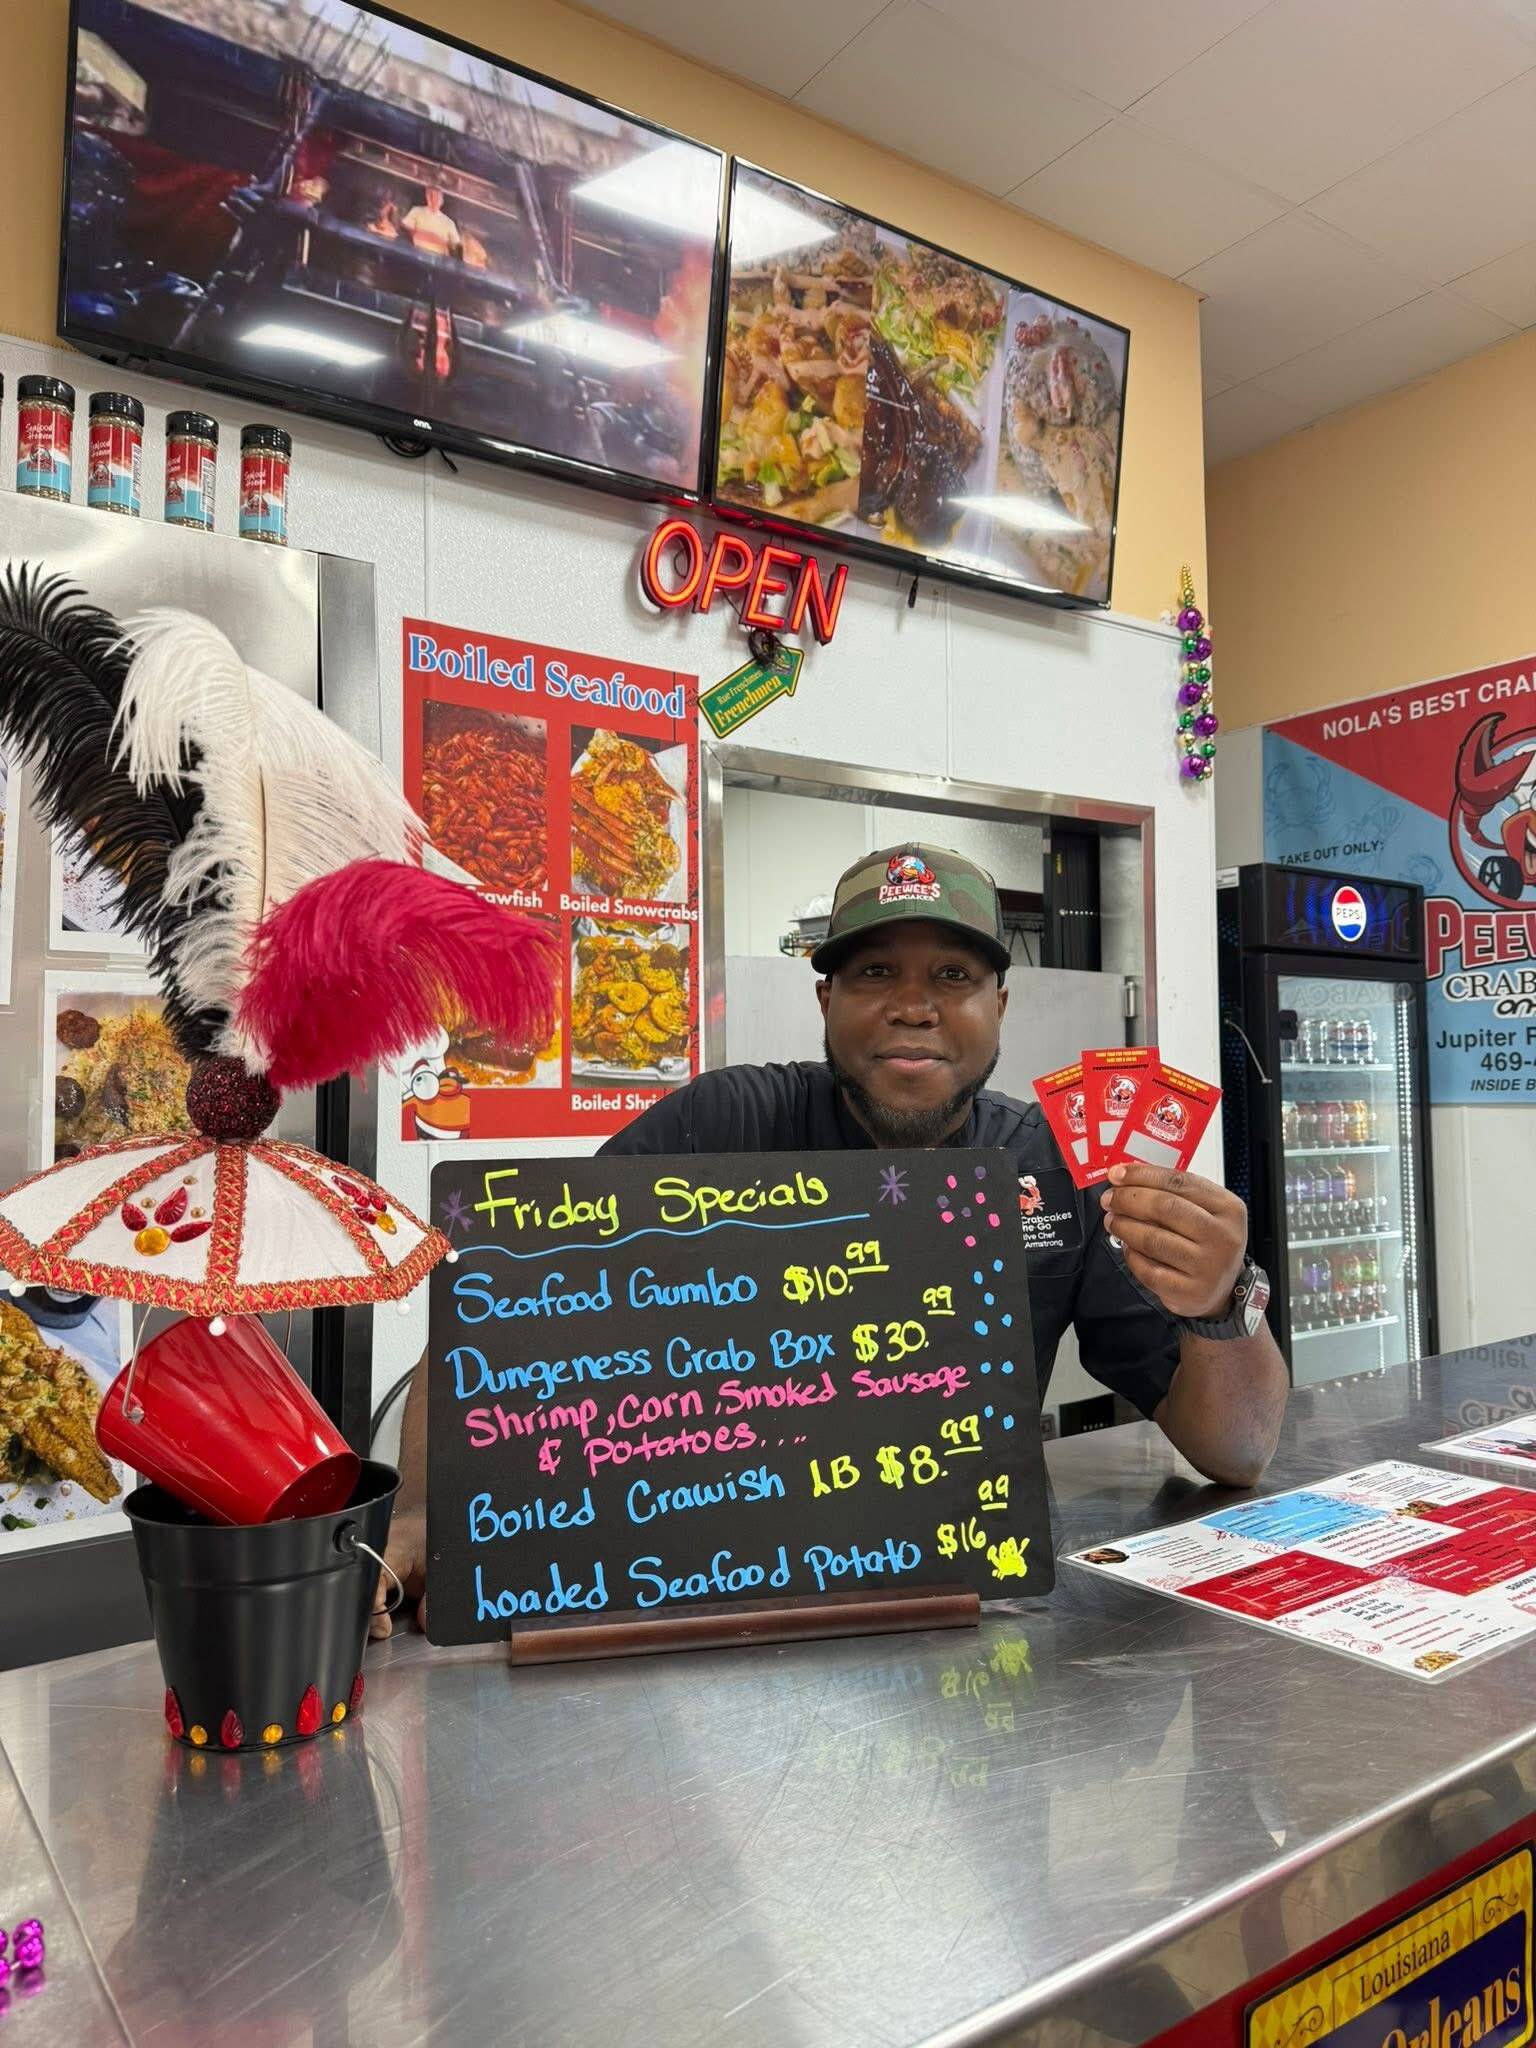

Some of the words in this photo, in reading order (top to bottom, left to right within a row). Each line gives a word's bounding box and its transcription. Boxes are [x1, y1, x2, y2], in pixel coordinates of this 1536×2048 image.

[642, 519, 848, 643] OPEN
[409, 633, 535, 692] Boiled
[545, 661, 686, 718] Seafood
[714, 675, 783, 727] Frenchmen
[1322, 704, 1403, 740] NOLA'S
[1409, 688, 1471, 721] BEST
[1477, 672, 1536, 704] CRA
[1278, 851, 1311, 866] TAKE
[1313, 846, 1340, 861] OUT
[1342, 839, 1385, 856] ONLY:
[466, 885, 543, 909] awfish
[559, 893, 610, 913] Boiled
[613, 898, 699, 921] Snowcrabs
[879, 882, 941, 901] PEEWEE'S
[1335, 906, 1363, 920] PEPSI
[1424, 896, 1536, 979] PEE
[1436, 1028, 1518, 1053] Jupiter
[1480, 1051, 1536, 1072] 469-
[571, 1093, 621, 1111] Boiled
[1471, 1079, 1522, 1091] INSIDE
[474, 1168, 620, 1237] Friday
[654, 1172, 830, 1226] Specials
[1021, 1211, 1073, 1225] Crabcakes
[1036, 1222, 1052, 1231] Go
[1037, 1231, 1056, 1240] Chef
[452, 1268, 613, 1325] Seafood
[628, 1267, 759, 1309] Gumbo
[445, 1346, 653, 1400] Dungeness
[666, 1336, 756, 1379] Crab
[769, 1328, 836, 1370] Box
[851, 1364, 971, 1398] Sausage
[537, 1437, 563, 1476] &
[469, 1487, 596, 1543] Boiled
[626, 1465, 786, 1524] Crawish
[475, 1560, 609, 1622] Loaded
[628, 1546, 792, 1608] Seafood
[803, 1538, 922, 1592] Potato
[1360, 1930, 1450, 2004] Louisiana
[1382, 1966, 1522, 2048] leans
